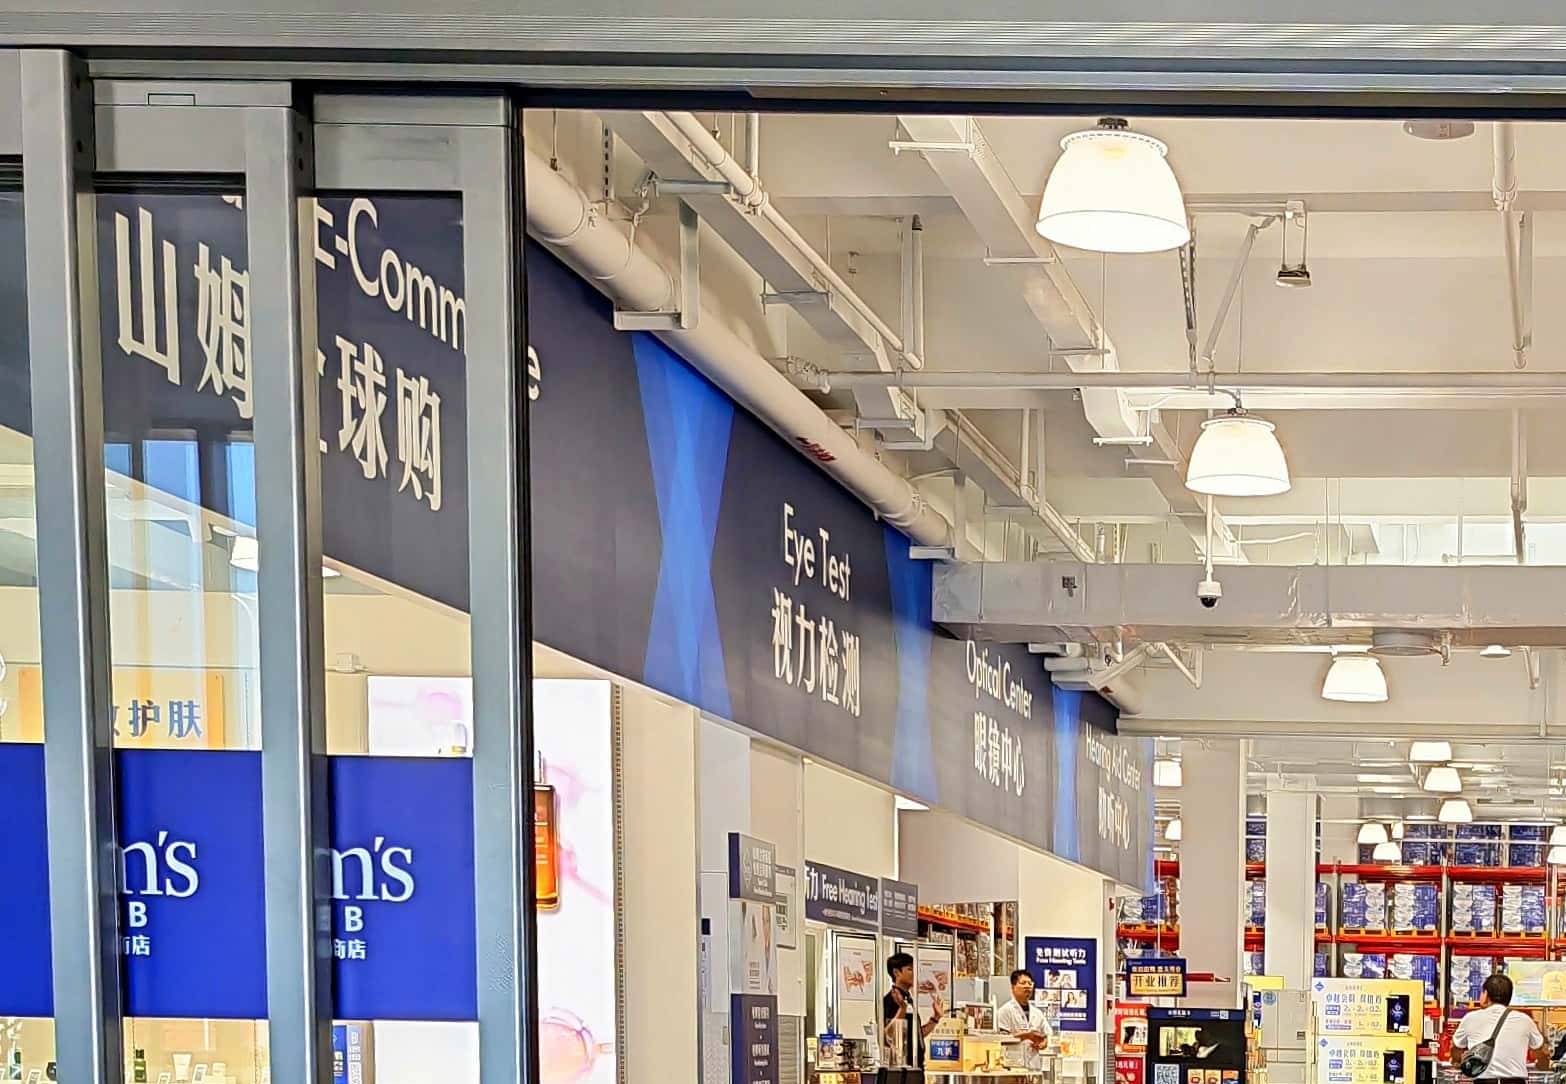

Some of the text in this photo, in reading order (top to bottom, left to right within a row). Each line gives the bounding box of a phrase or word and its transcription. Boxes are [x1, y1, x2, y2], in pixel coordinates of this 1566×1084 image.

[784, 503, 851, 601] Eye Test
[771, 587, 861, 718] 视力检测
[966, 640, 1033, 720] Optical Center
[974, 711, 1025, 797] 眼镜中心
[1086, 721, 1111, 782] Hearing
[822, 873, 838, 902] Free
[839, 878, 866, 916] Hearing
